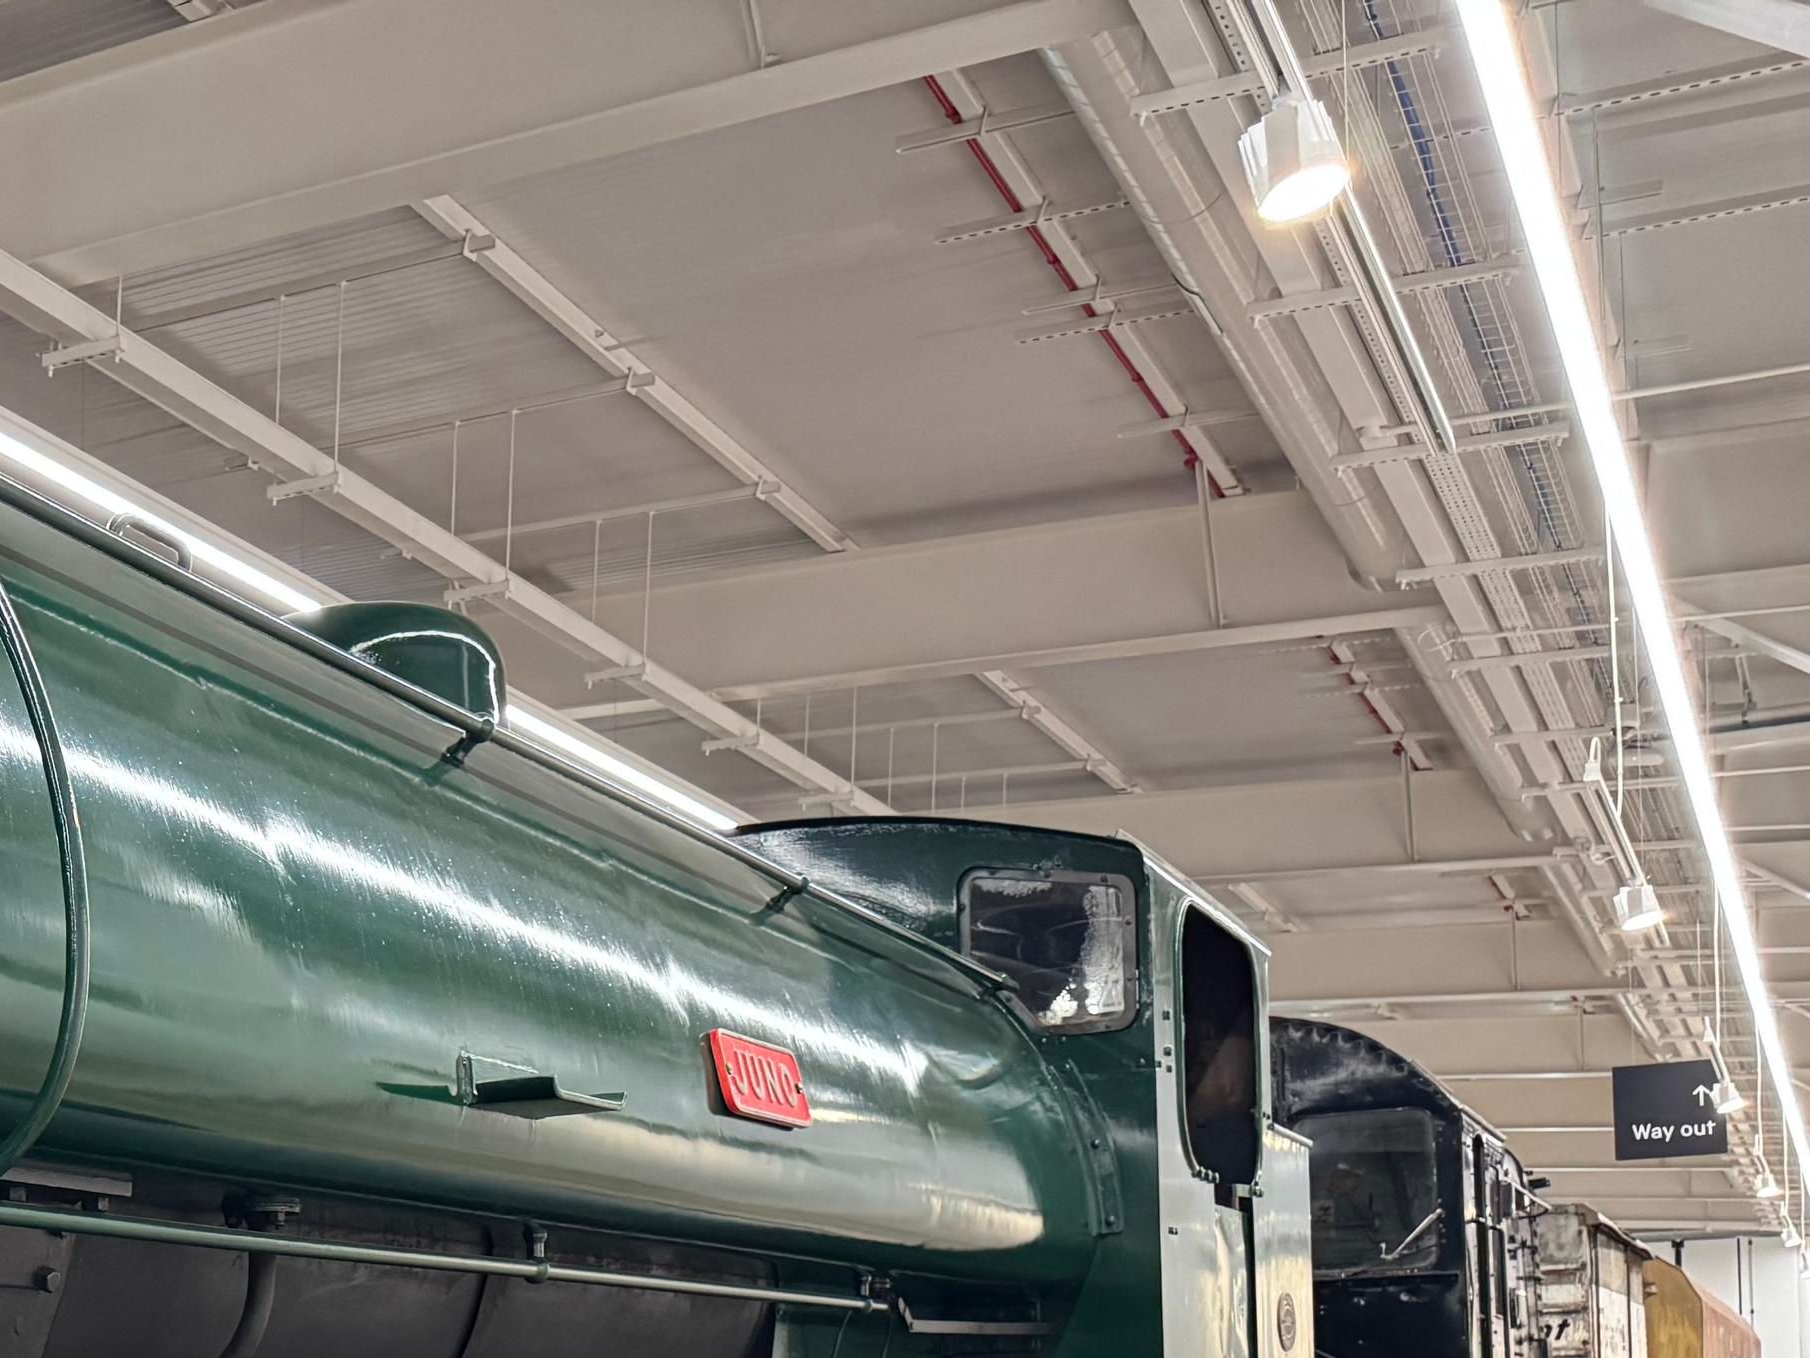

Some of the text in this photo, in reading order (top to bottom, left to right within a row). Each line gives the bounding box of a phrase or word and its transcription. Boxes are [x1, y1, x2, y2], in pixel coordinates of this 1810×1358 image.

[731, 1049, 797, 1108] JUNO
[1631, 1119, 1716, 1143] Way out
